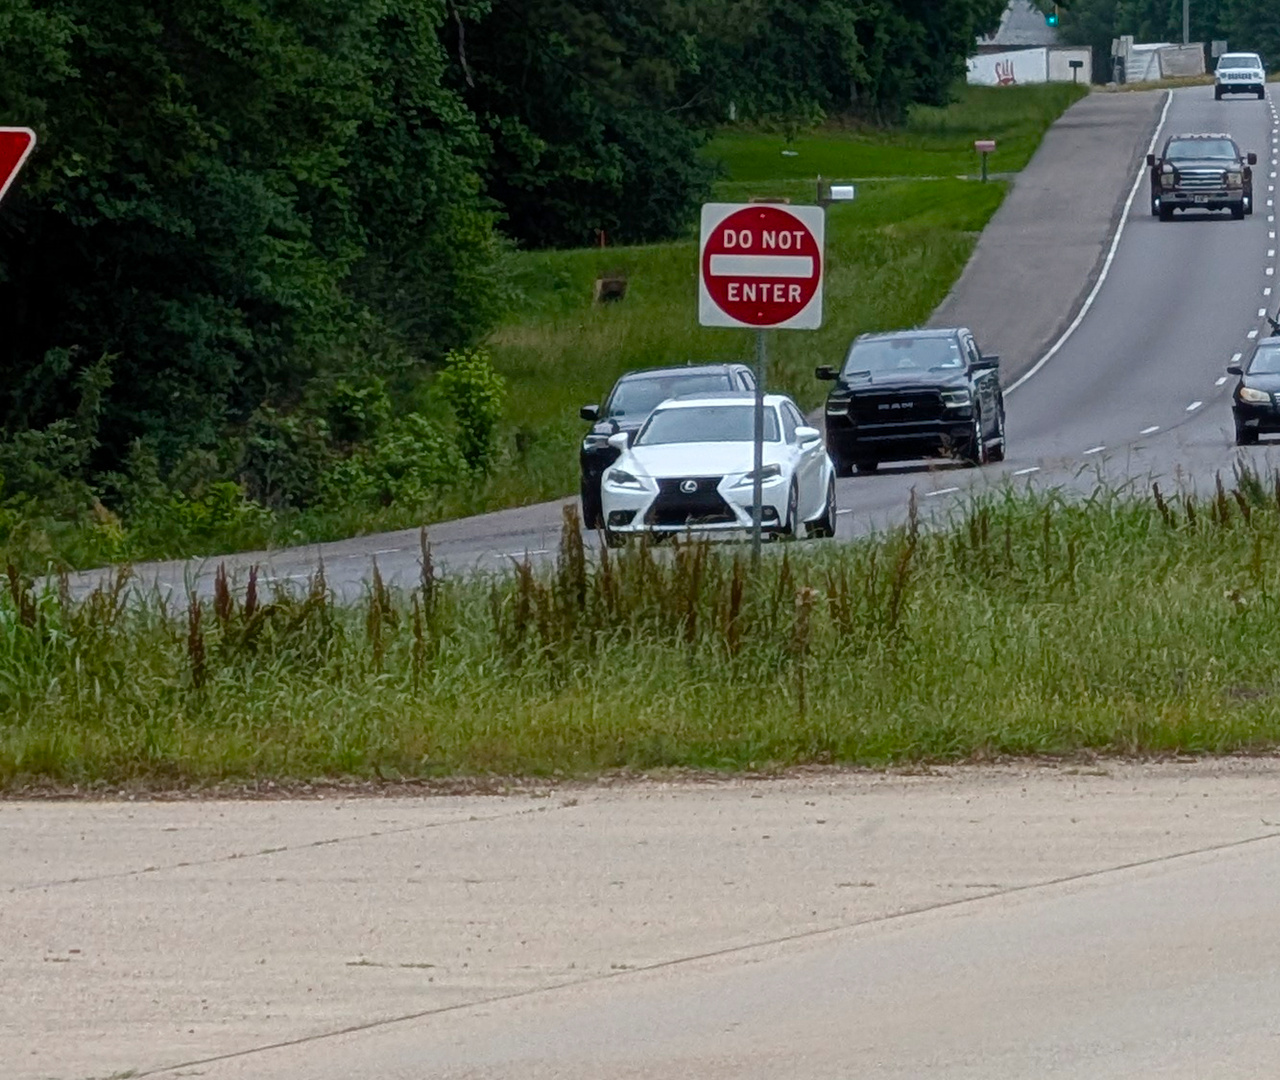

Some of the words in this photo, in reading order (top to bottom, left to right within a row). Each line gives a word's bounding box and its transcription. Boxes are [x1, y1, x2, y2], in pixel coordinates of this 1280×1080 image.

[723, 229, 753, 249] DO
[762, 230, 805, 250] NOT
[727, 282, 802, 303] ENTER
[877, 401, 914, 410] RAM
